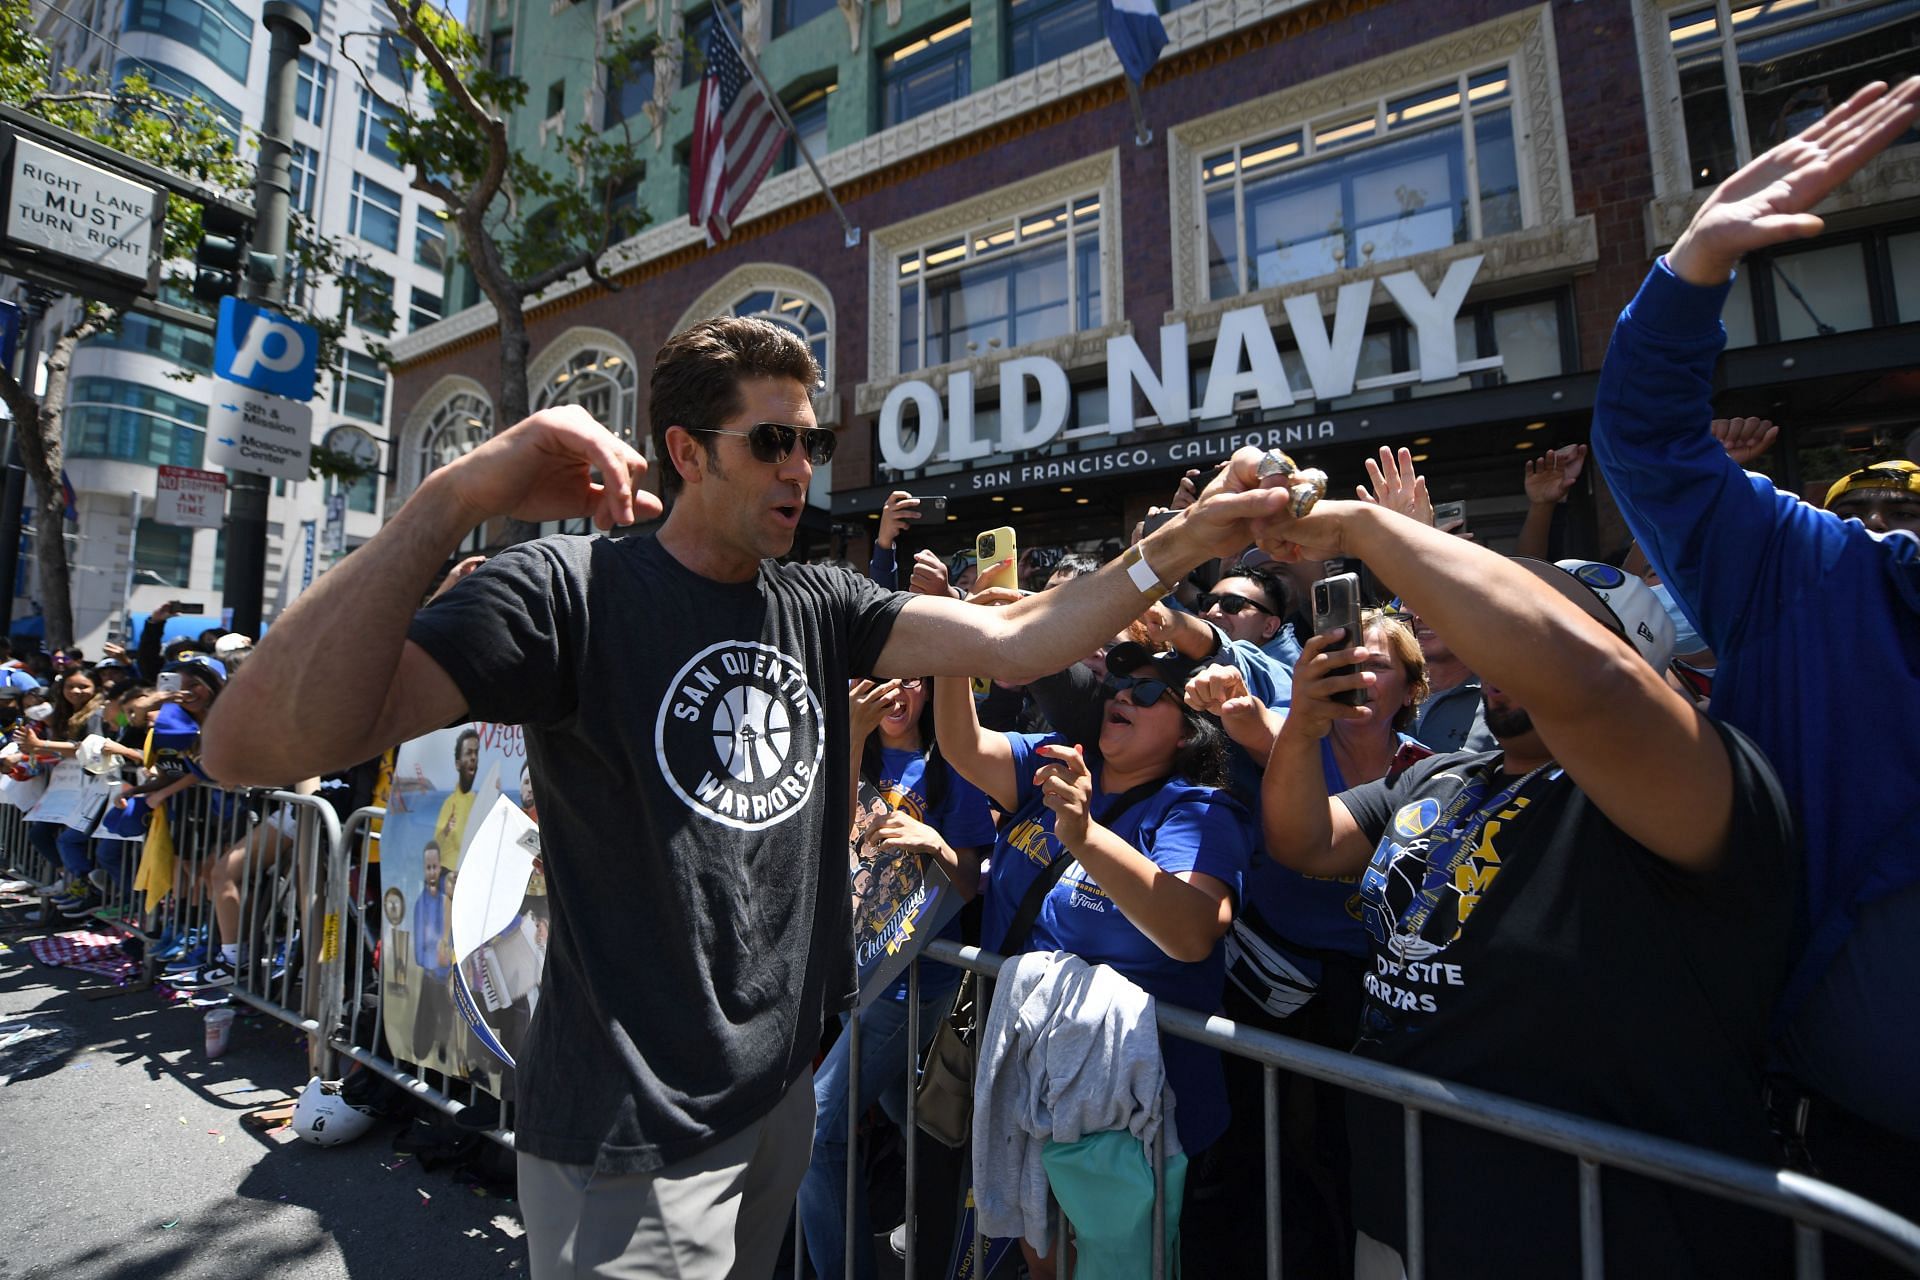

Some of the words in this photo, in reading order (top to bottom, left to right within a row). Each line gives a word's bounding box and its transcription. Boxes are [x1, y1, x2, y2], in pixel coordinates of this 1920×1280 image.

[23, 163, 82, 195] RIGHT
[96, 191, 145, 219] LANE
[45, 191, 122, 230] MUST
[19, 204, 73, 233] TURN
[88, 229, 142, 256] RIGHT
[878, 356, 1072, 472] OLD
[1106, 254, 1486, 435] NAVY
[243, 412, 297, 436] Mission
[244, 401, 267, 416] 5th
[270, 408, 280, 419] &
[240, 446, 287, 466] Center
[241, 434, 303, 459] Moscone
[972, 471, 1012, 490] SAN
[1021, 448, 1156, 483] FRANCISCO,
[1168, 420, 1335, 460] CALIFORNIA
[160, 476, 177, 490] NO
[179, 478, 226, 495] STOPPING
[178, 492, 206, 504] ANY
[176, 503, 207, 517] TIME
[673, 665, 721, 722] SAN
[694, 760, 811, 820] WARRIORS
[1077, 893, 1105, 913] Finals
[857, 885, 927, 967] Champions
